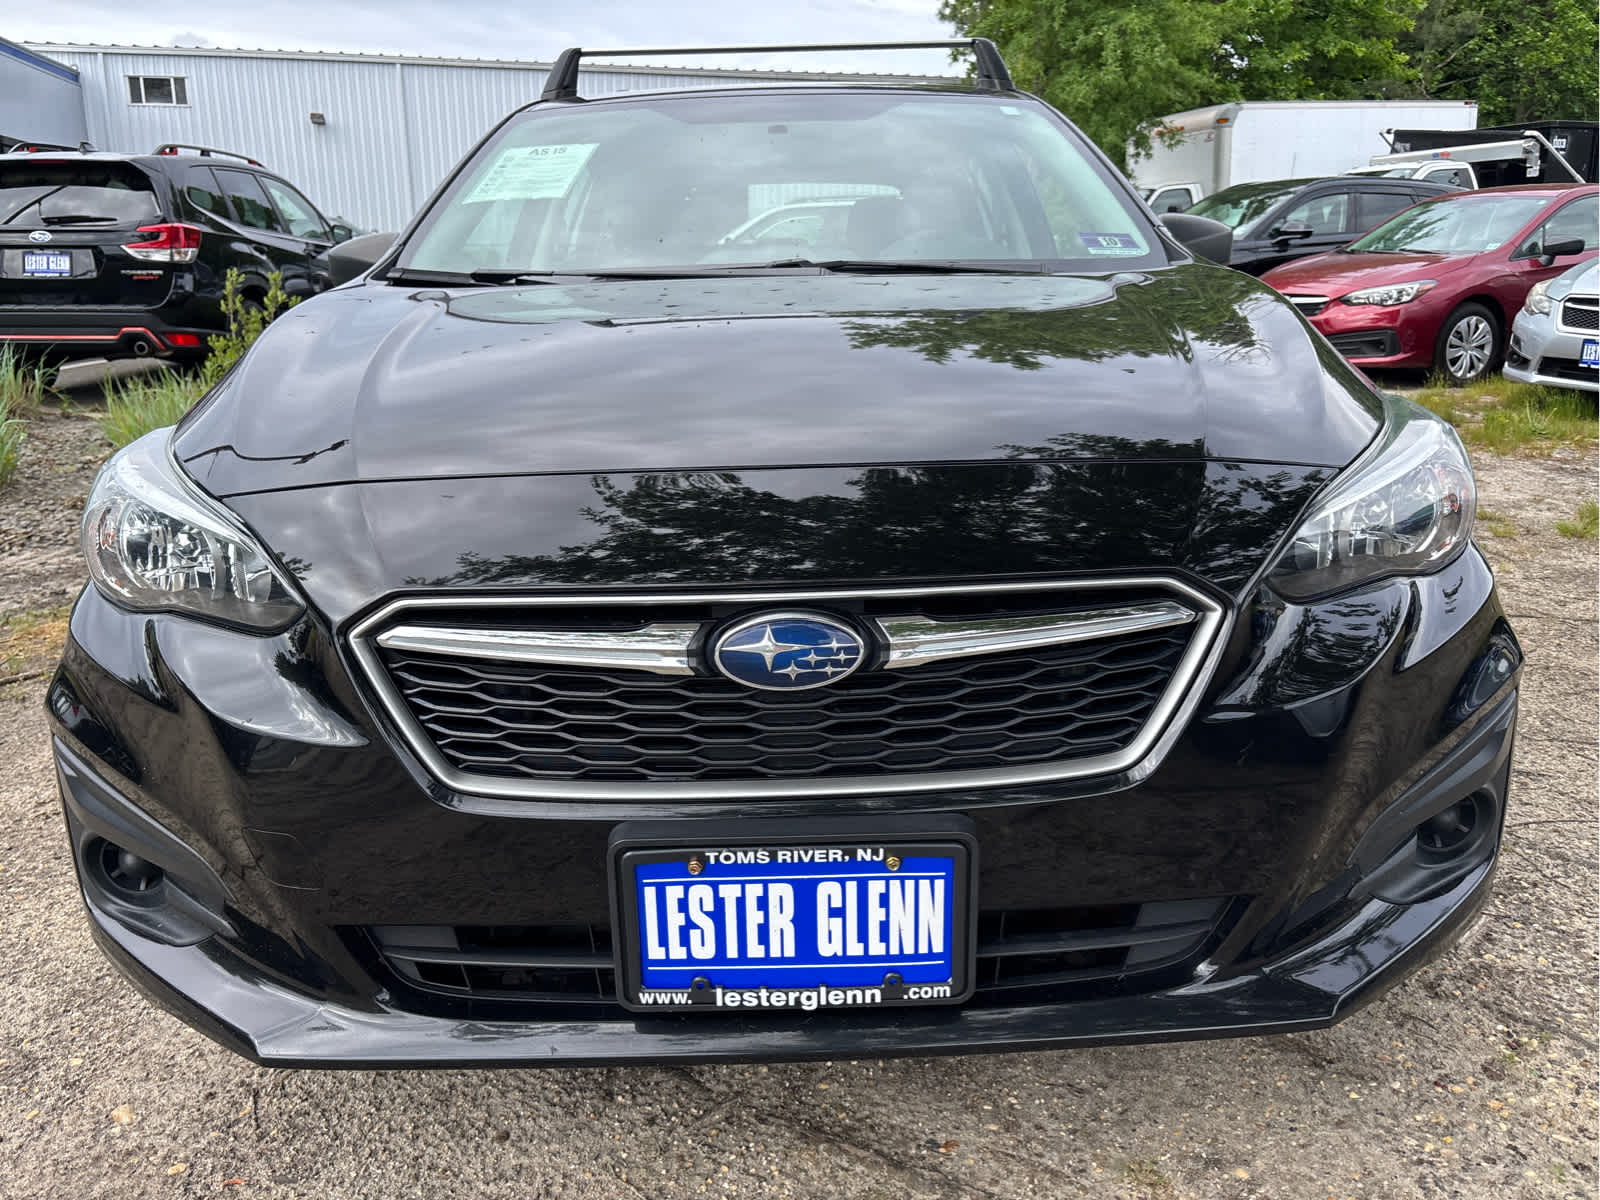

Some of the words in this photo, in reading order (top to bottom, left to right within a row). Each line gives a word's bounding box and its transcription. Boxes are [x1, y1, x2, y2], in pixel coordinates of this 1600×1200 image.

[528, 147, 550, 156] AS
[553, 146, 568, 155] IS
[705, 850, 770, 864] TOMS
[777, 849, 850, 863] RIVER,
[856, 848, 884, 861] NJ
[644, 883, 796, 959] LESTER
[816, 879, 945, 957] GLENN
[715, 986, 882, 1011] lesterglenn
